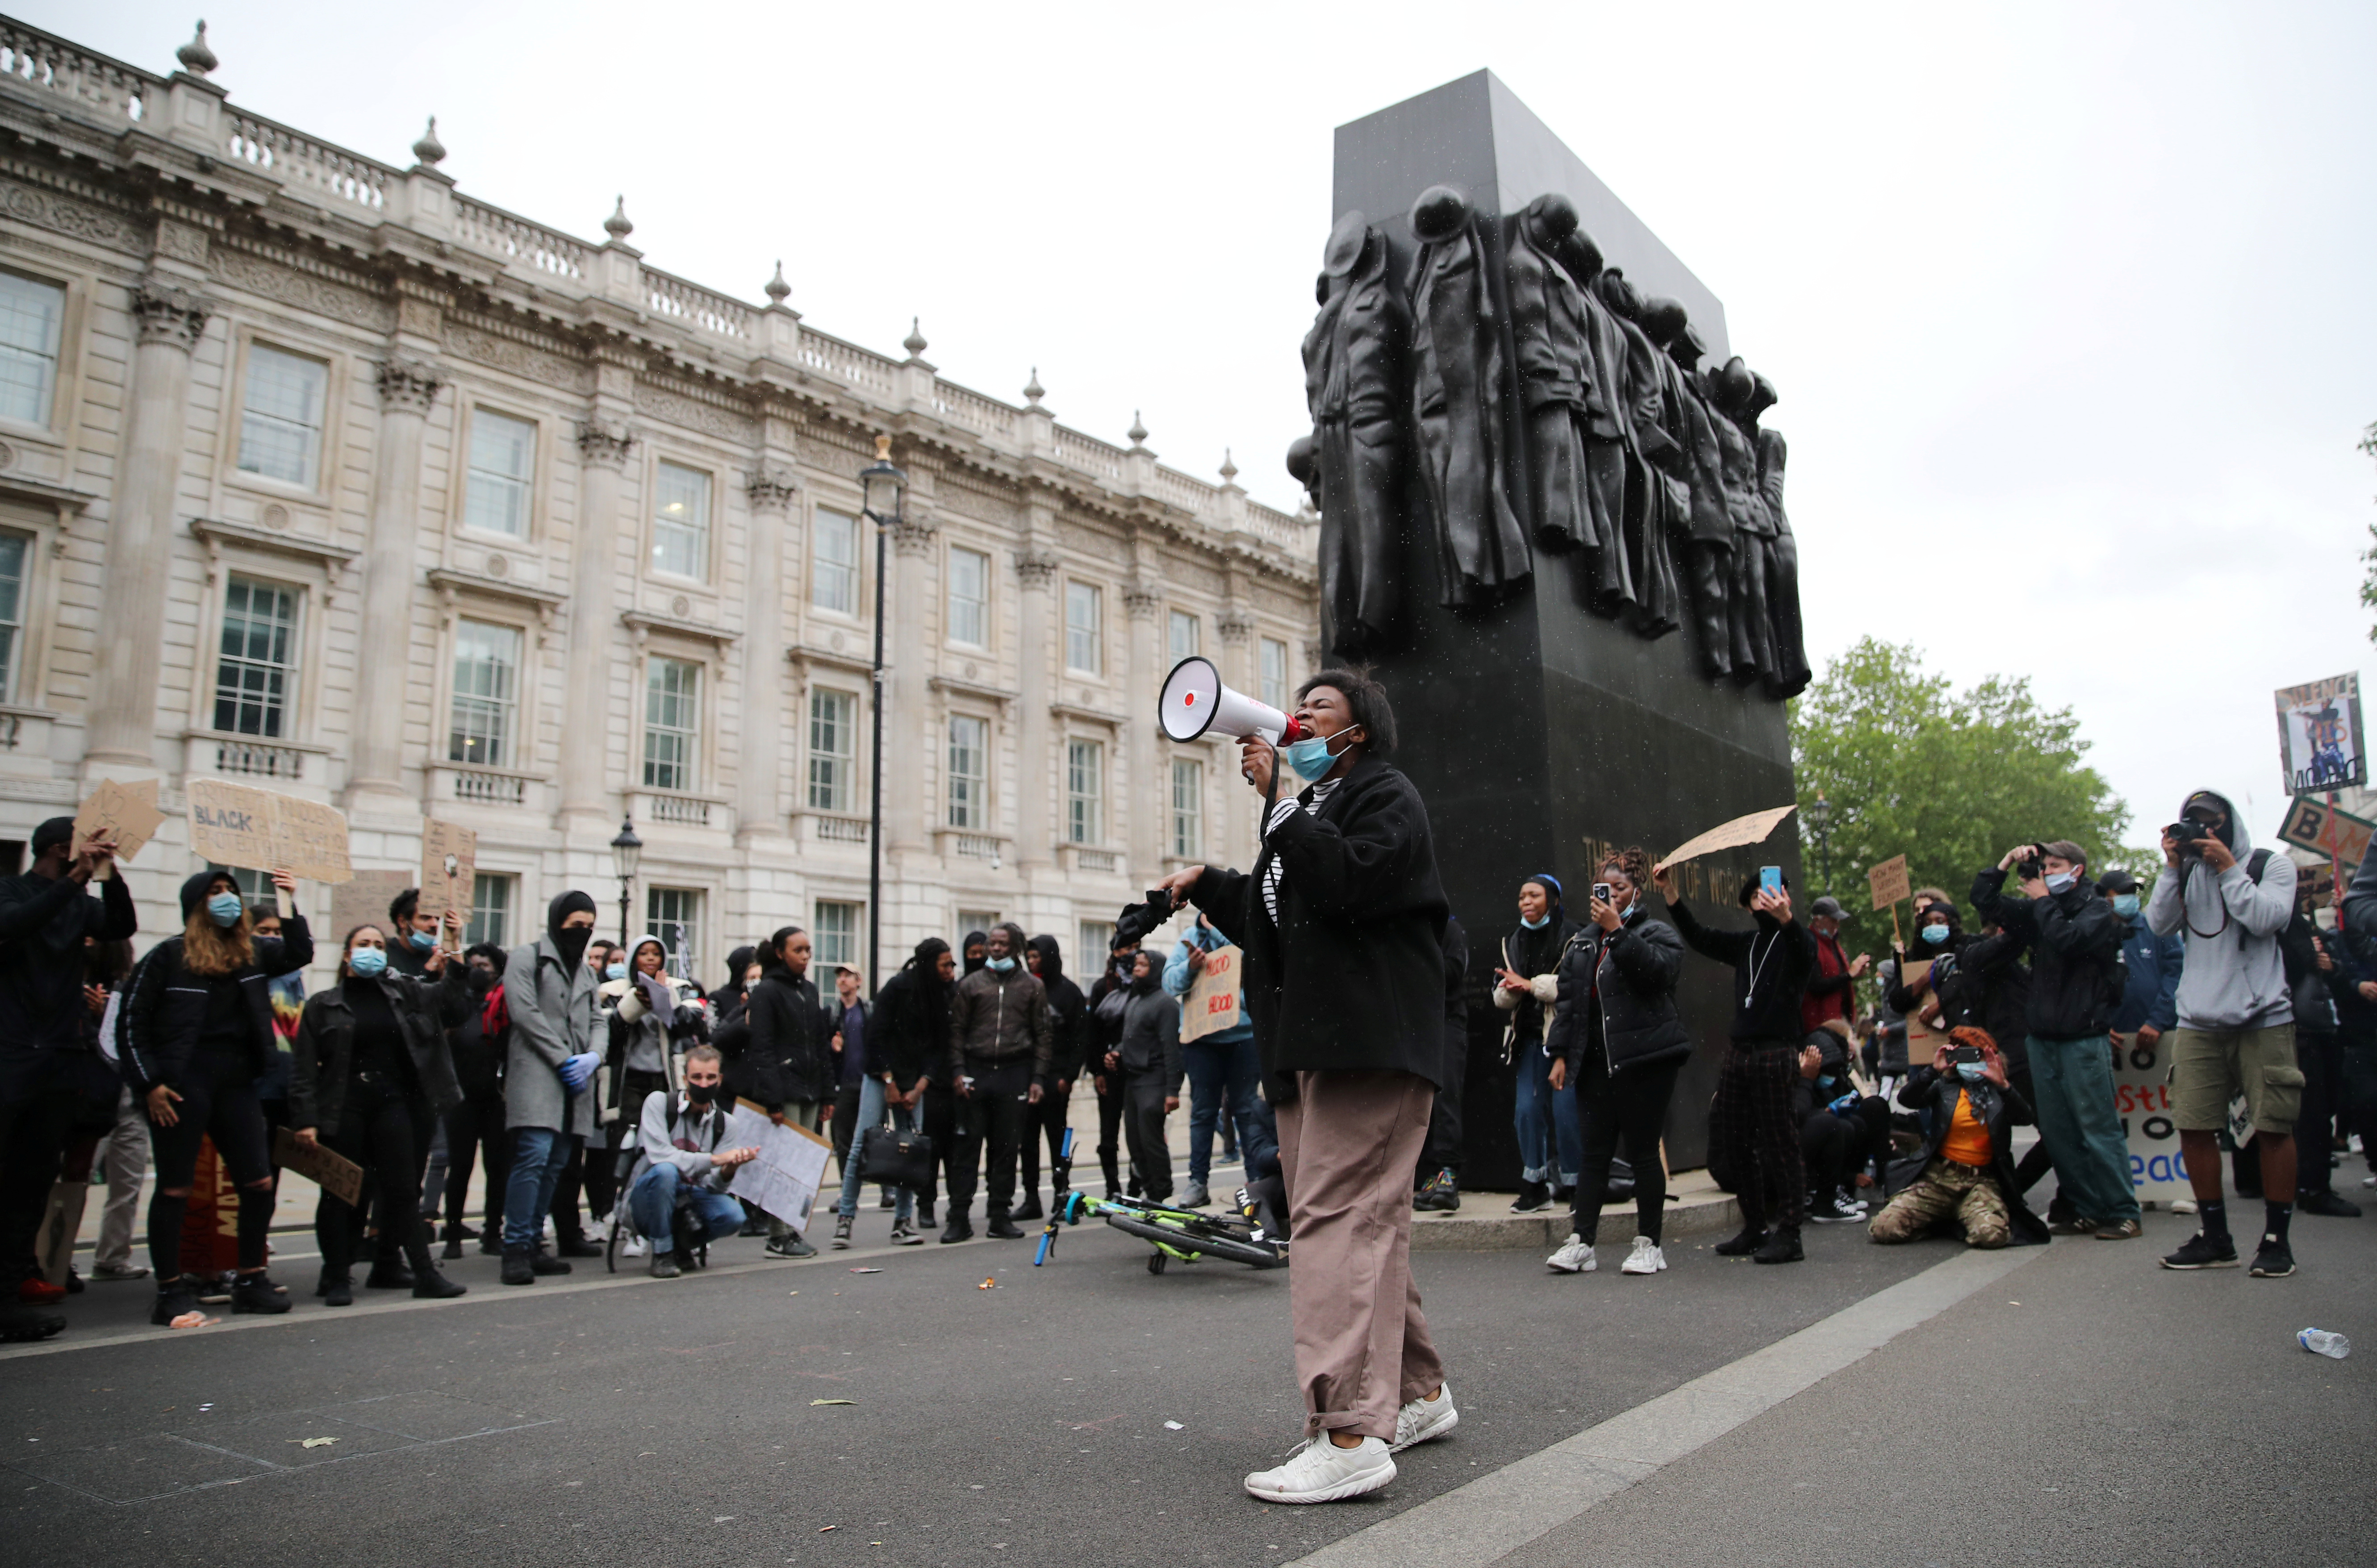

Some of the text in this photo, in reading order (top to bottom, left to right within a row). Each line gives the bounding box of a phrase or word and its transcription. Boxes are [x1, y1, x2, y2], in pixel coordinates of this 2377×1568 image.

[2276, 672, 2357, 713] SILENCE
[2323, 718, 2348, 744] IS
[2283, 755, 2364, 795] VIOLENCE
[91, 788, 125, 817] NO
[194, 782, 266, 813] PROTECT
[194, 805, 253, 832] BLACK
[196, 827, 258, 853] PROTECT
[2293, 807, 2373, 862] BLM
[1685, 862, 1702, 900] OF
[1205, 955, 1231, 977] BLOOD
[1208, 993, 1233, 1015] BLOOD
[216, 1152, 240, 1237] MATT
